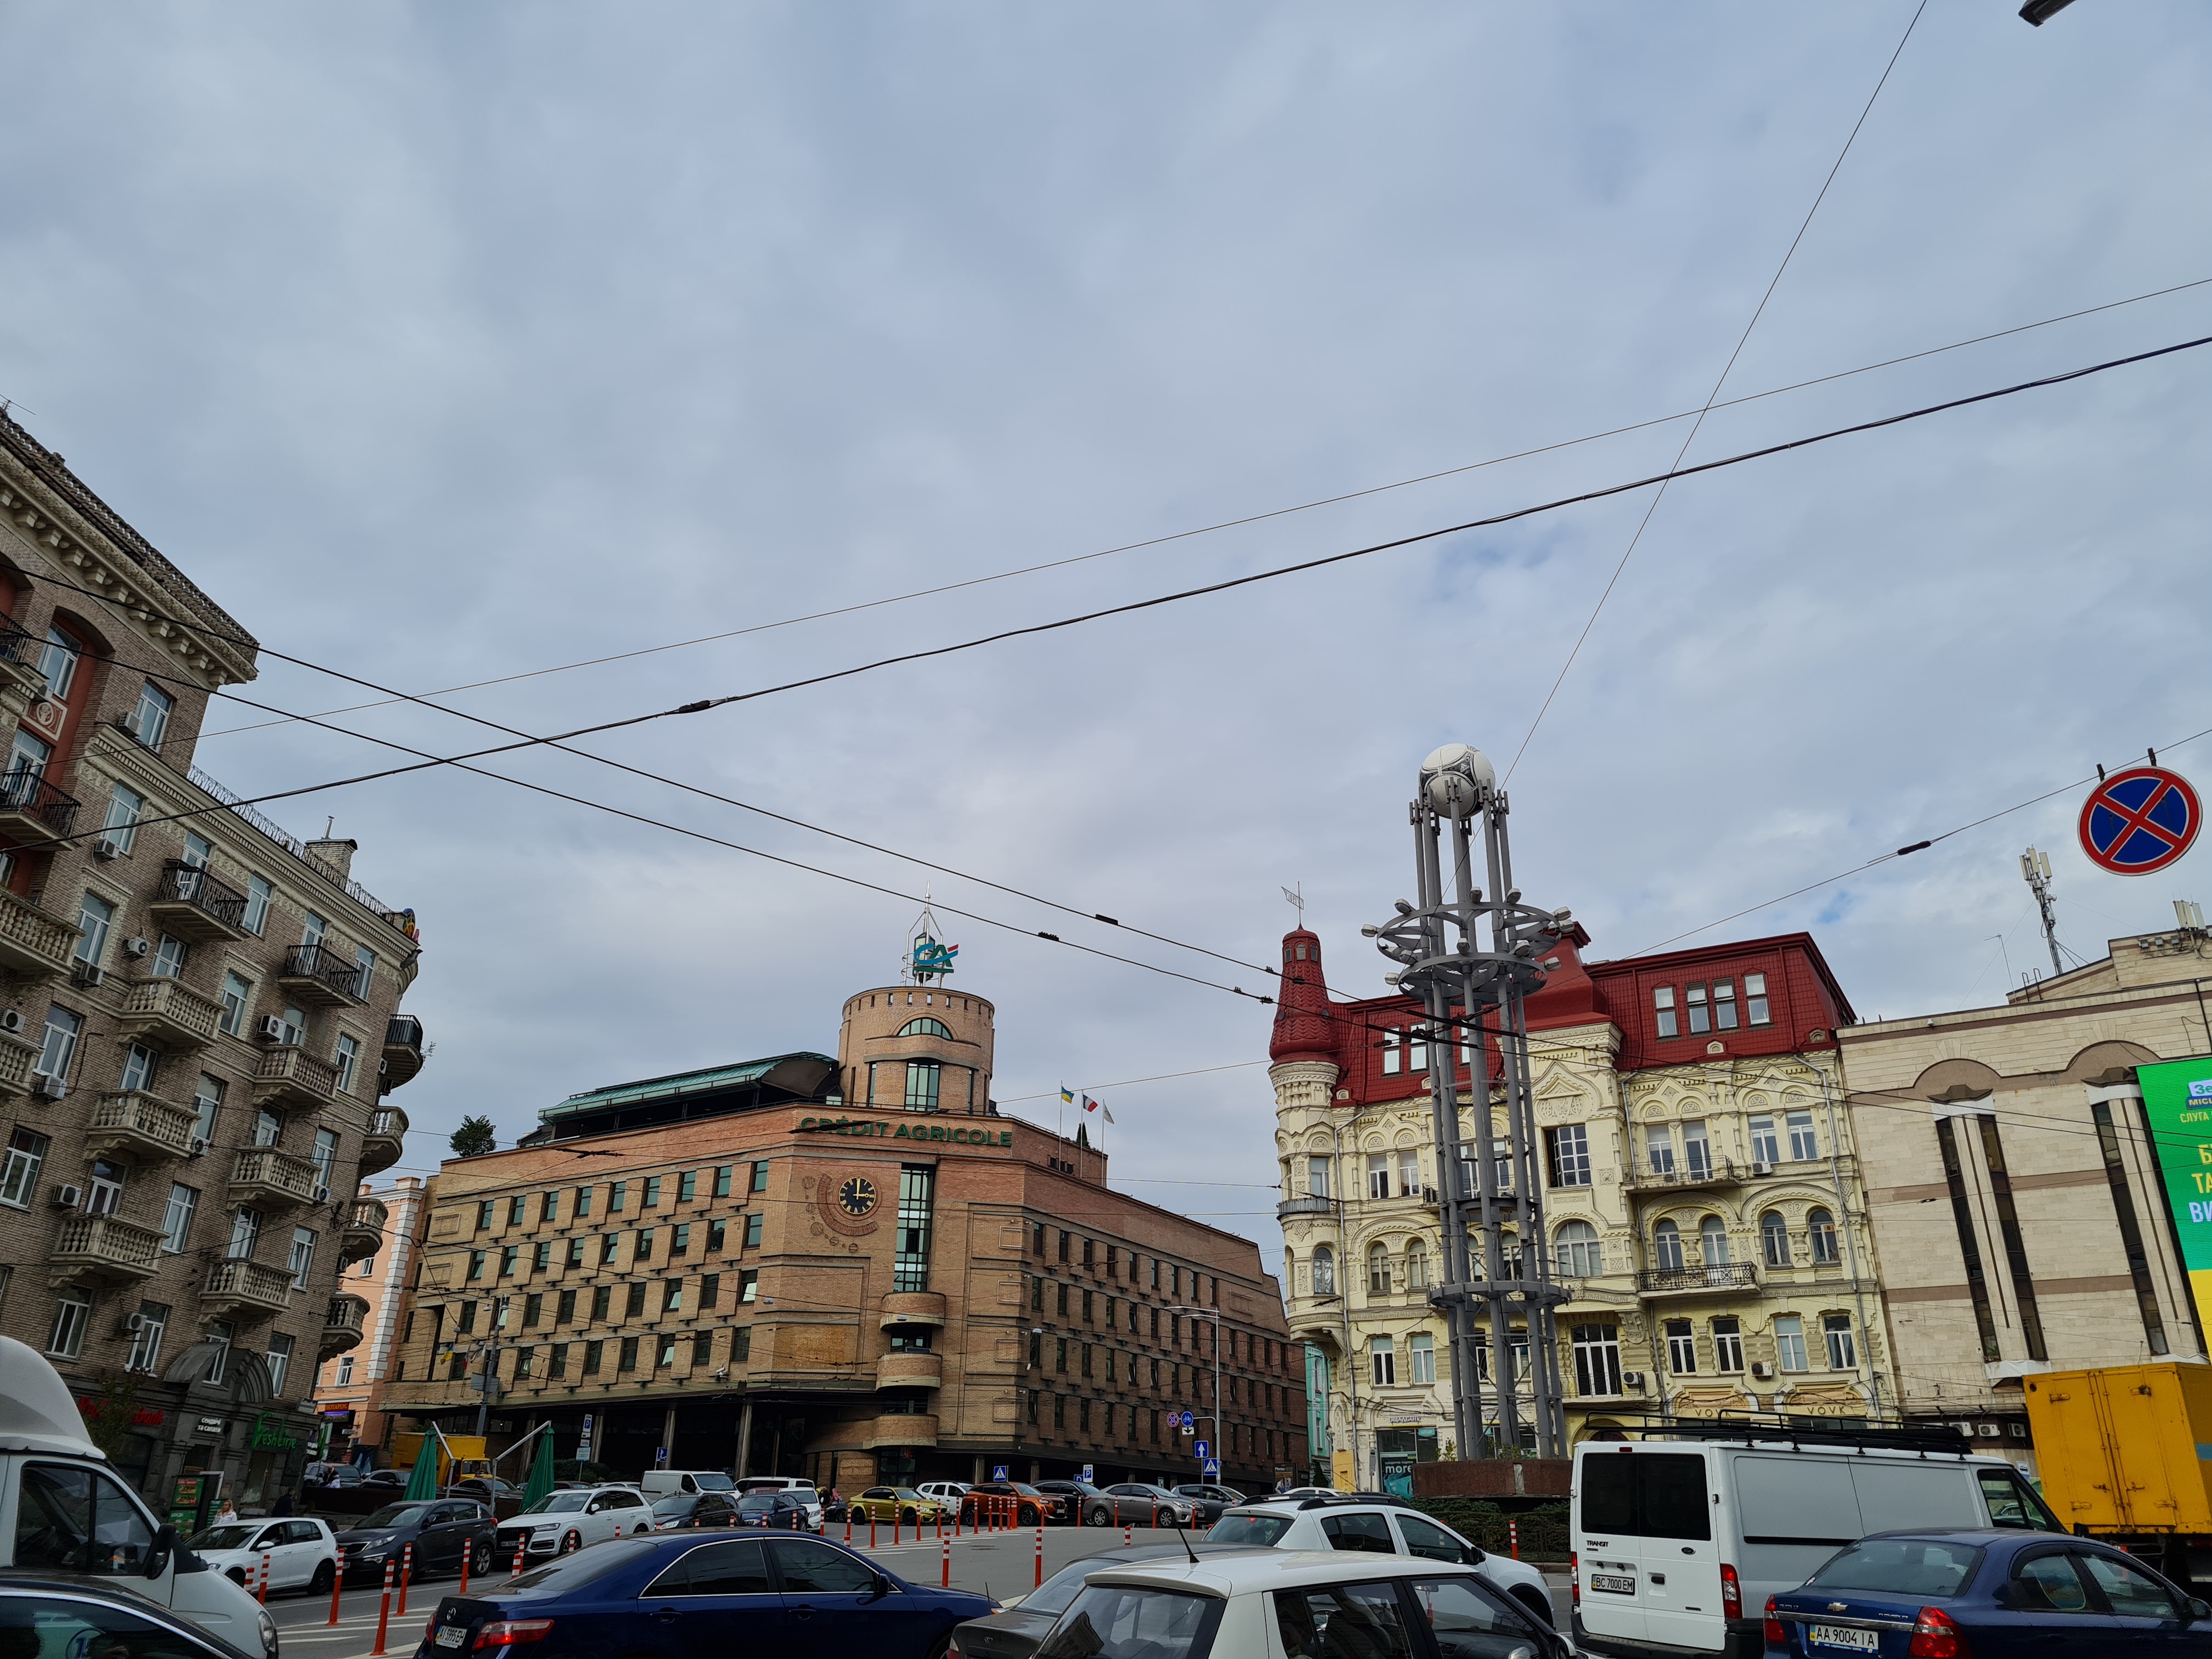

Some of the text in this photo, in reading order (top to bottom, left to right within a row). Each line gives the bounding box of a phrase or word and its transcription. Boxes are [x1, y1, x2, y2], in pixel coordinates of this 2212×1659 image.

[800, 1115, 1013, 1147] CRÉDIT AGRICOLE
[1807, 1406, 1846, 1414] VOVK
[1385, 1465, 1412, 1473] more
[1596, 1577, 1633, 1591] BC 7000 EM
[1816, 1627, 1830, 1641] AA
[1833, 1629, 1857, 1645] 9004
